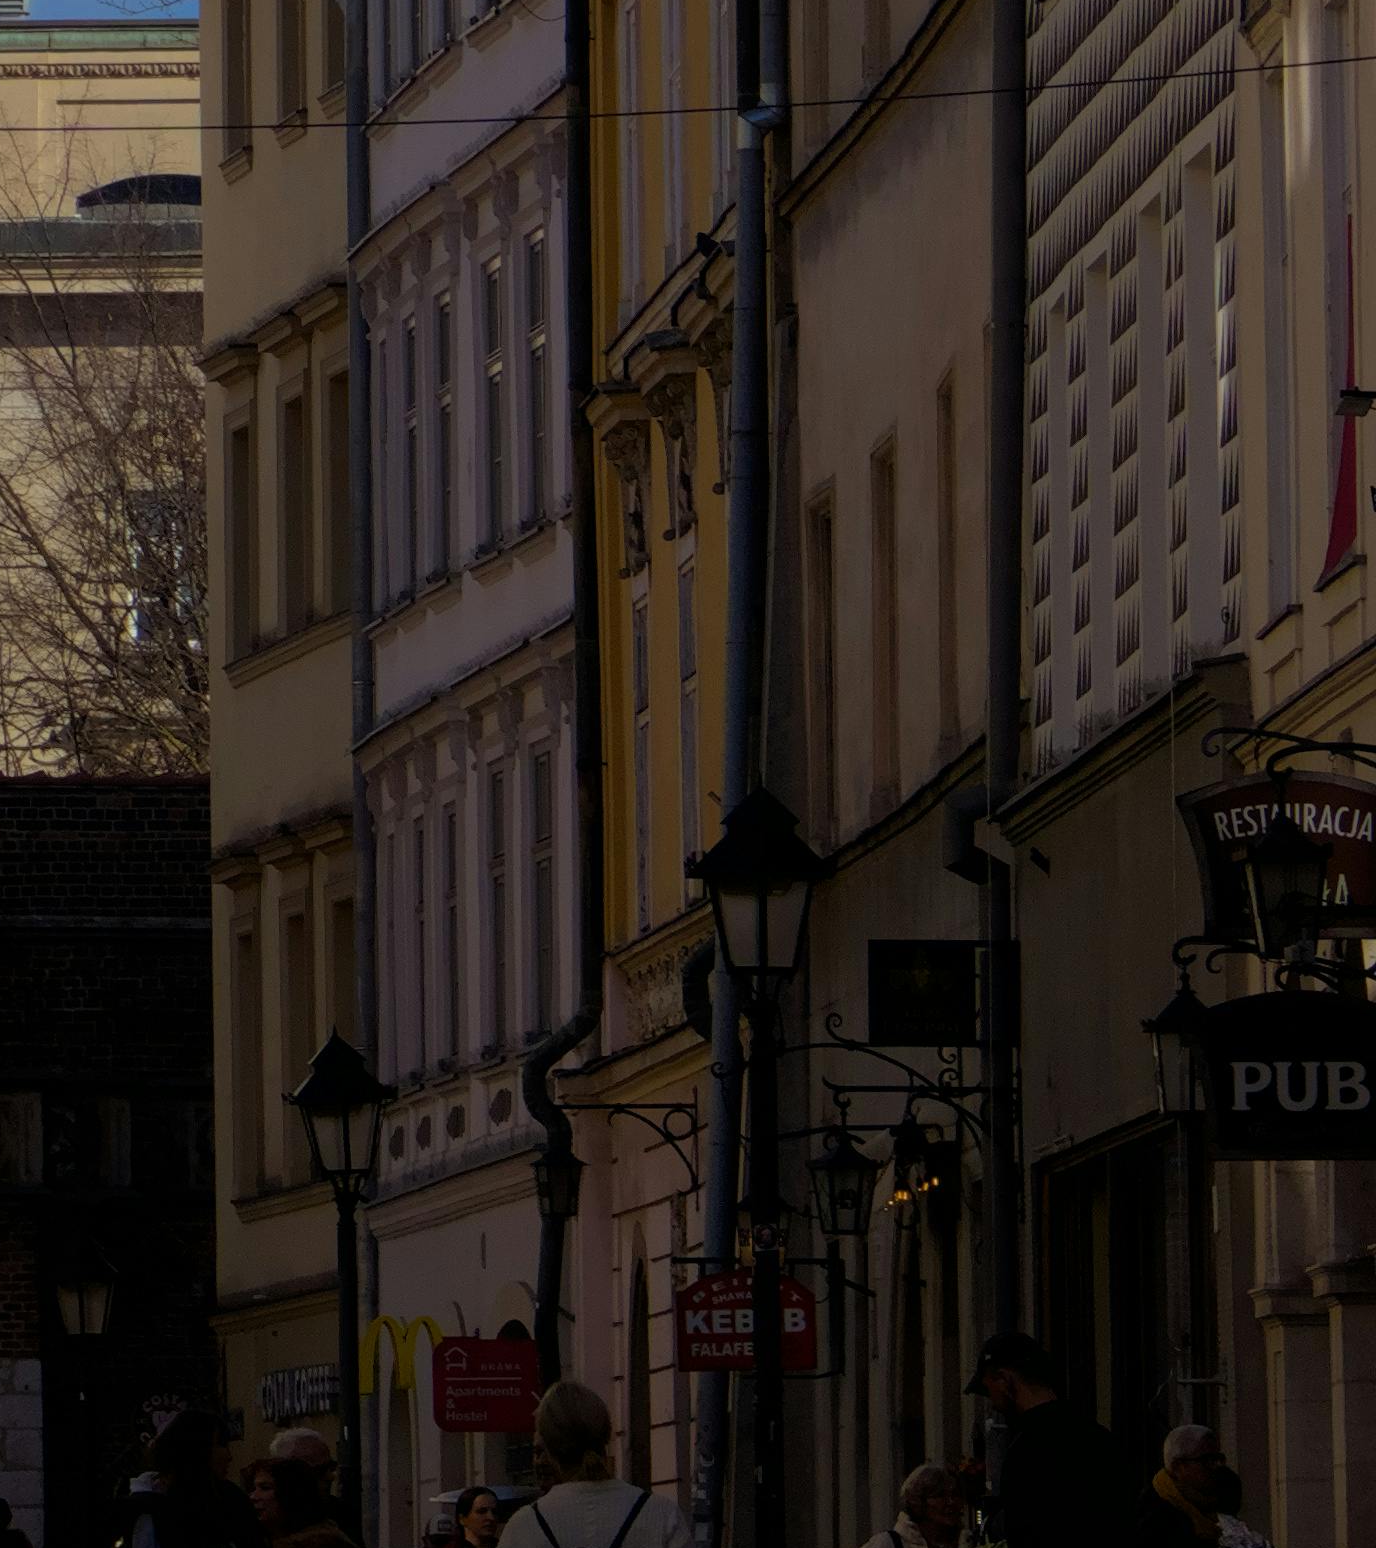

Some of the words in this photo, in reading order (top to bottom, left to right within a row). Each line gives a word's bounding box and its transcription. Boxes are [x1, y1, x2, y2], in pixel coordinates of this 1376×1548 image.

[1230, 1060, 1374, 1112] PUB
[711, 1291, 753, 1305] SHAWA
[684, 1307, 807, 1334] KEBB
[689, 1341, 755, 1358] FALAFE
[445, 1385, 521, 1398] Apartments
[445, 1410, 488, 1422] Hostel
